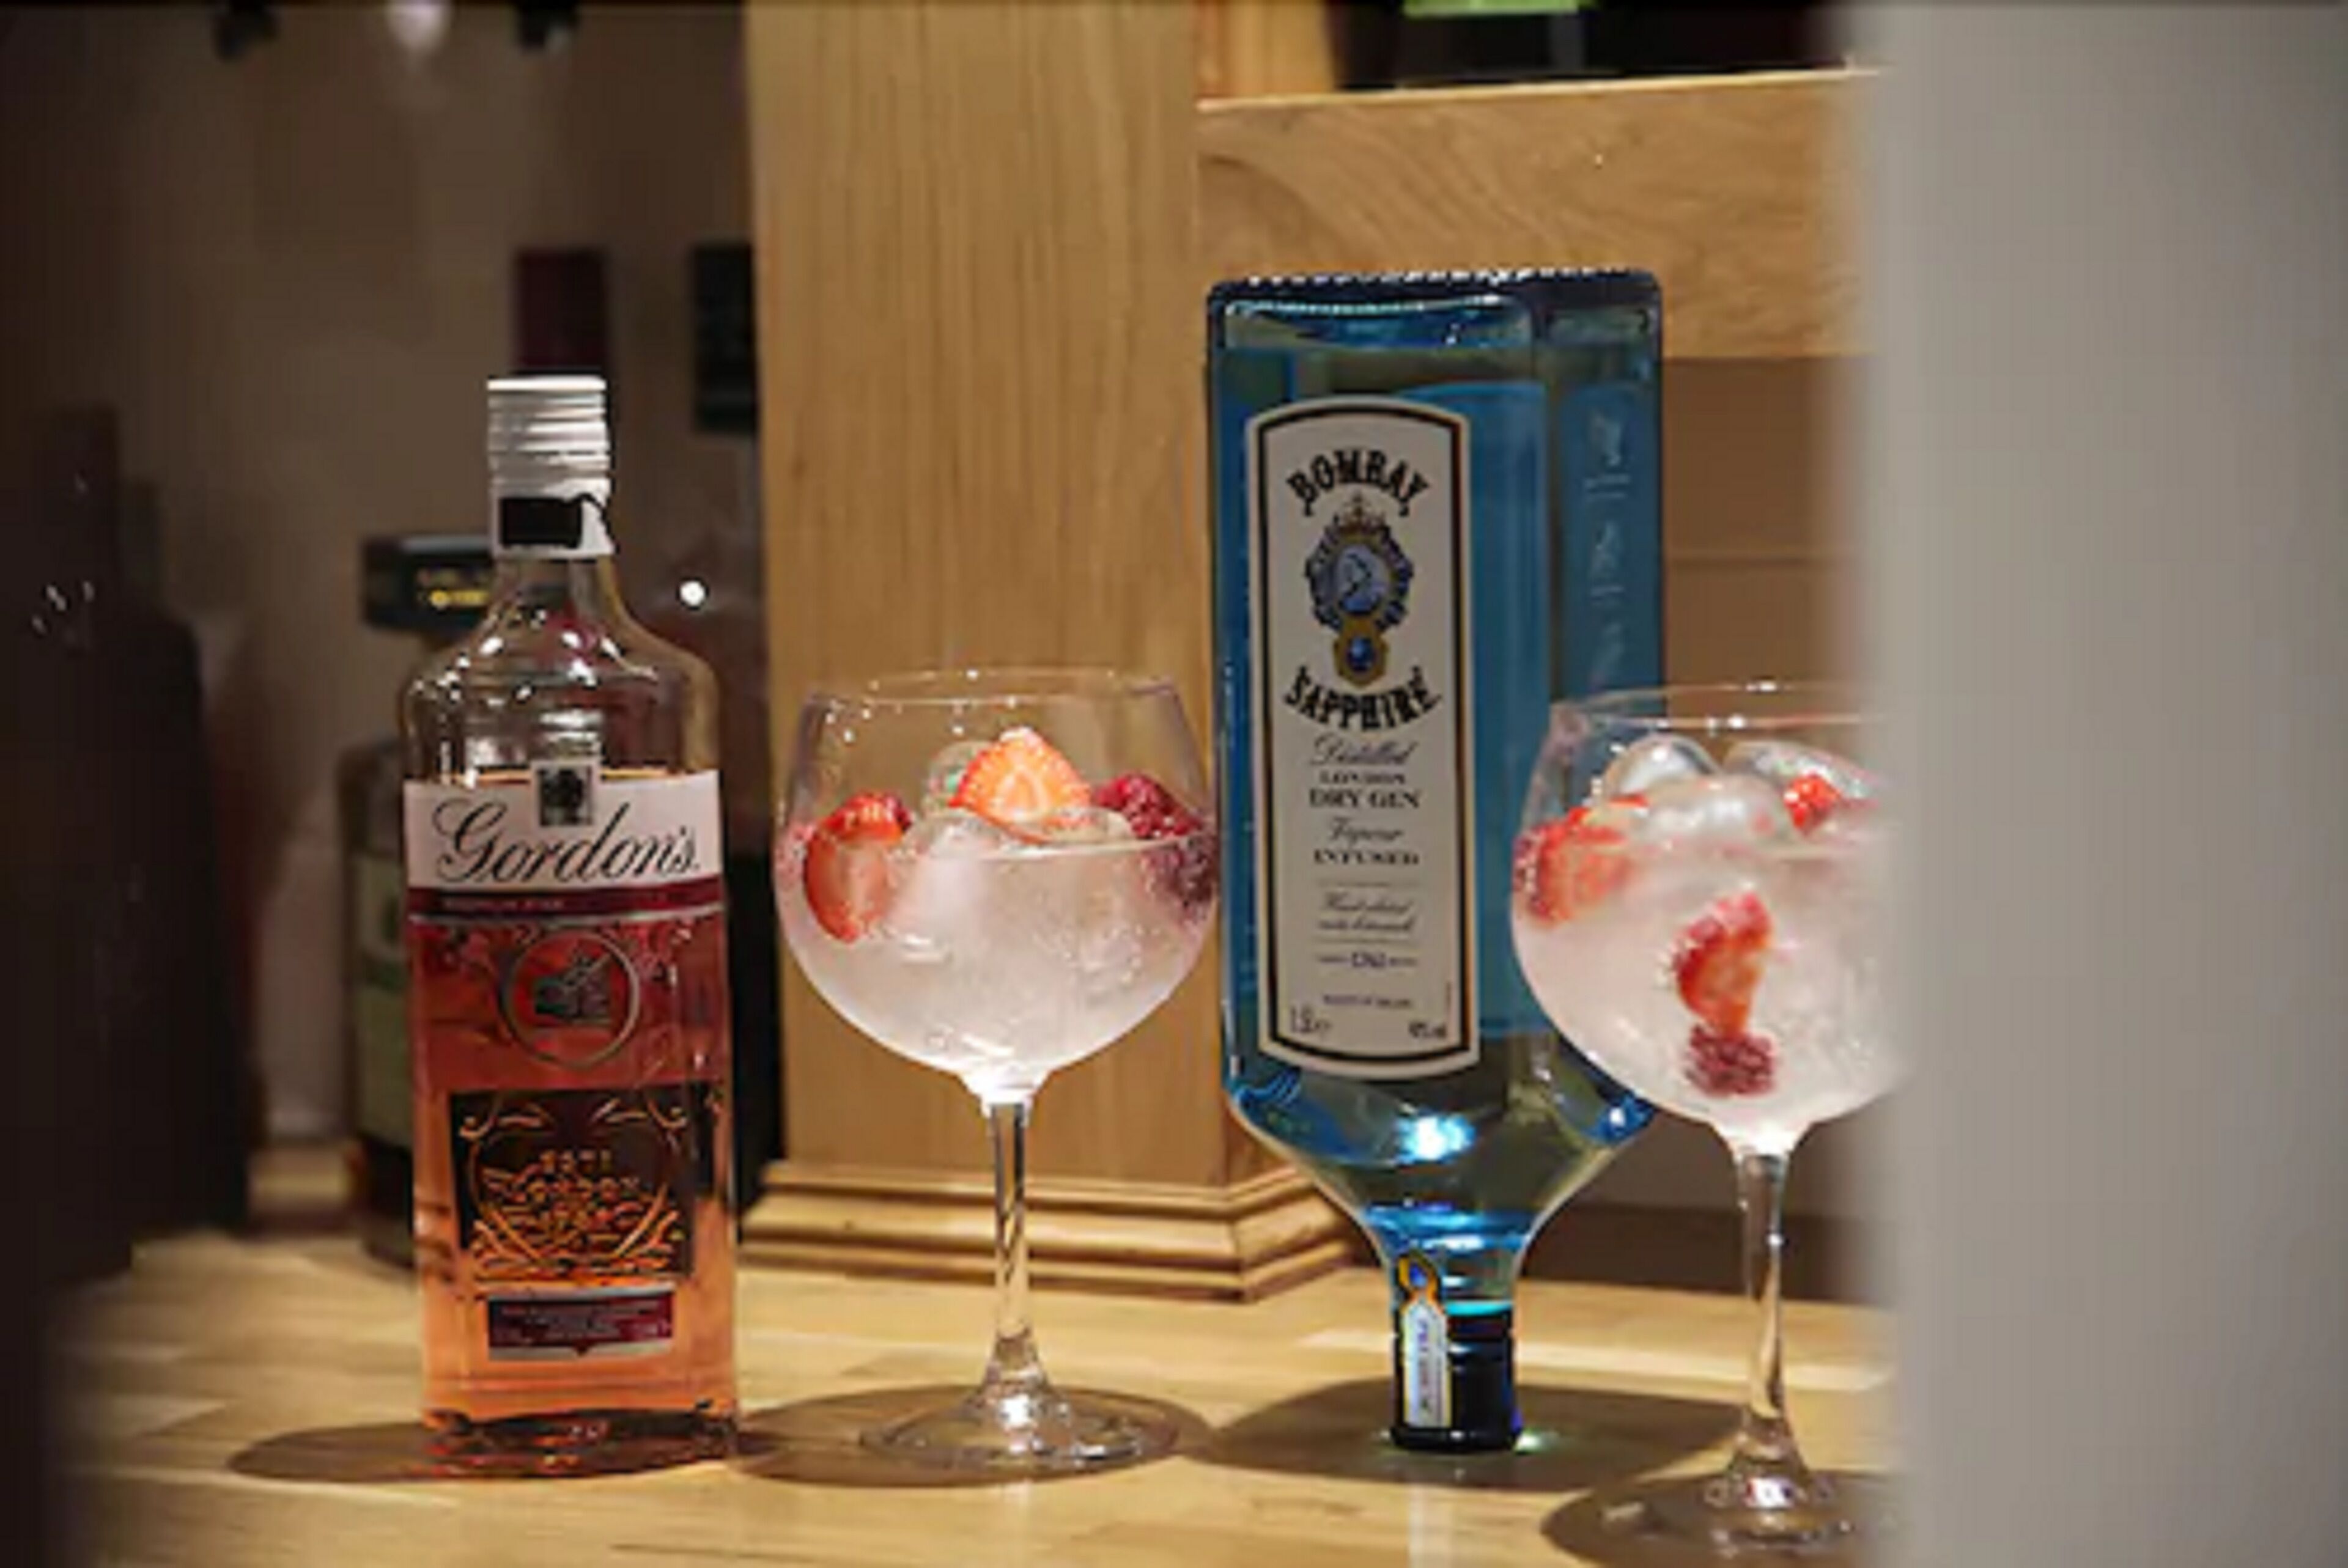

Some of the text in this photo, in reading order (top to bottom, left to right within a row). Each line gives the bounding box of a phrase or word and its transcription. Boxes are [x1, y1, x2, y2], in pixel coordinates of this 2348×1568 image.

[1287, 448, 1430, 517] BOMBAY
[1284, 666, 1442, 732] SAPPHIRE
[1310, 789, 1362, 808] DRY
